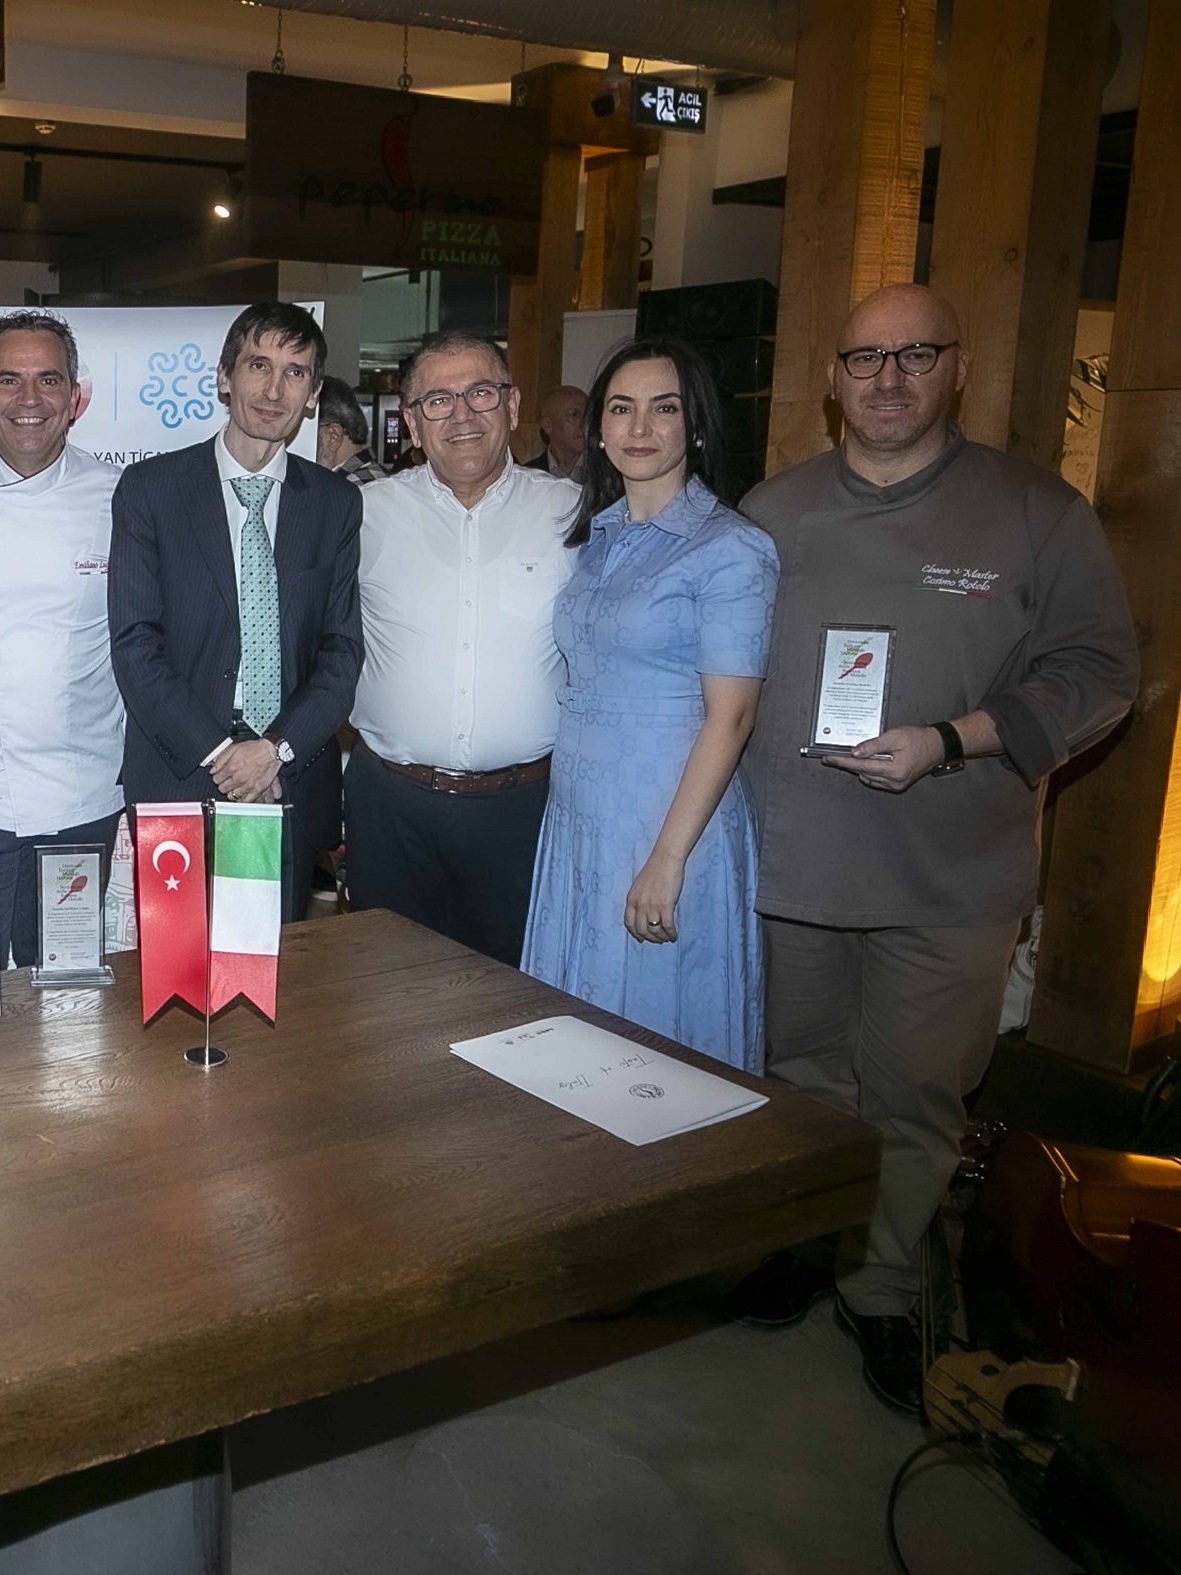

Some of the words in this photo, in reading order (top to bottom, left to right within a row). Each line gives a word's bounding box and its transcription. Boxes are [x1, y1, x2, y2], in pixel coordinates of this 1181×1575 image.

[677, 106, 701, 124] ÇIKIŞ
[420, 219, 503, 246] PIZZA
[419, 248, 502, 266] ITALIANA
[93, 451, 125, 464] YAN
[921, 563, 952, 575] Cheese
[963, 568, 1000, 580] Master
[922, 575, 956, 587] Cosimo
[958, 578, 991, 591] Rotolo
